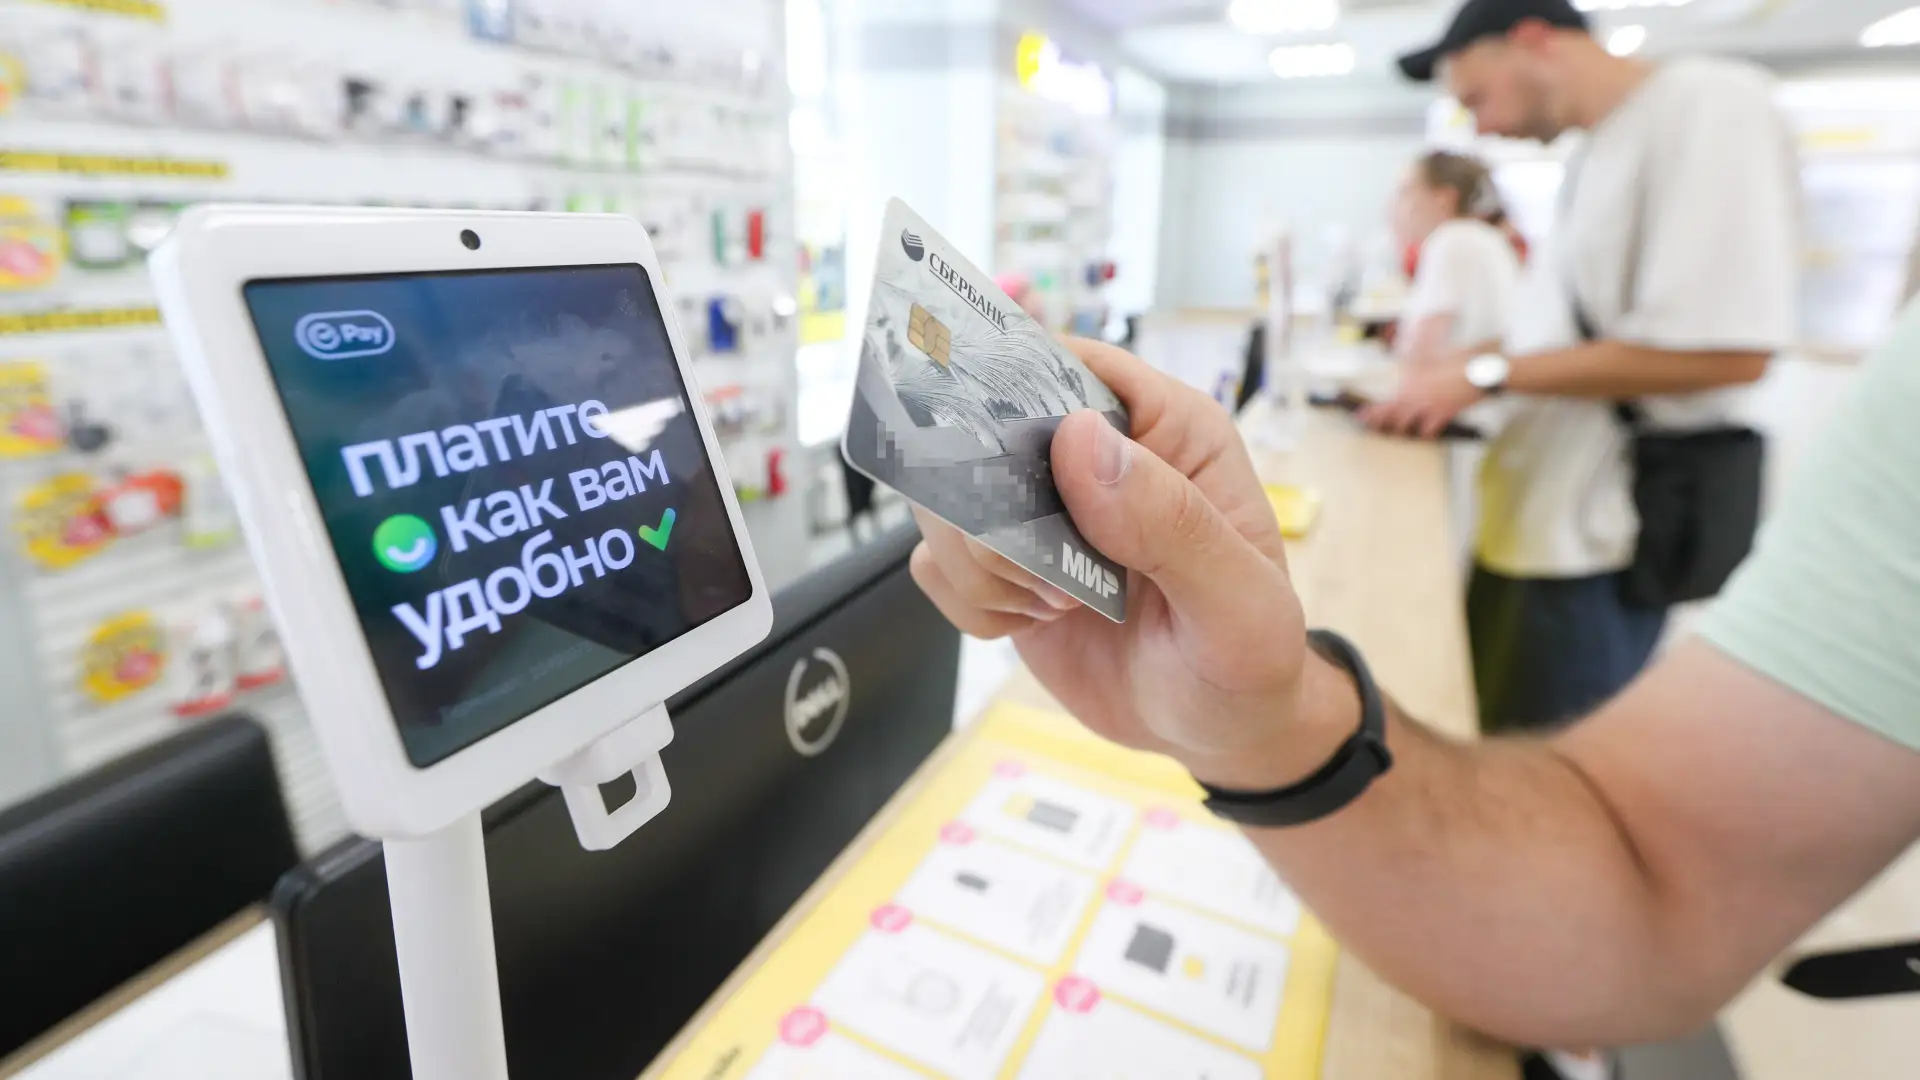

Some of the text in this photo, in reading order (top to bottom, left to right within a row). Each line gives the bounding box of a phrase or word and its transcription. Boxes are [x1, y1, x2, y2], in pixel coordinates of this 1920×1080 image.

[340, 323, 382, 345] Pay
[929, 252, 1006, 331] СБЕРБАНК
[340, 399, 612, 497] платите
[440, 448, 671, 553] как вам
[391, 528, 636, 670] удобно
[1062, 541, 1119, 599] МИР
